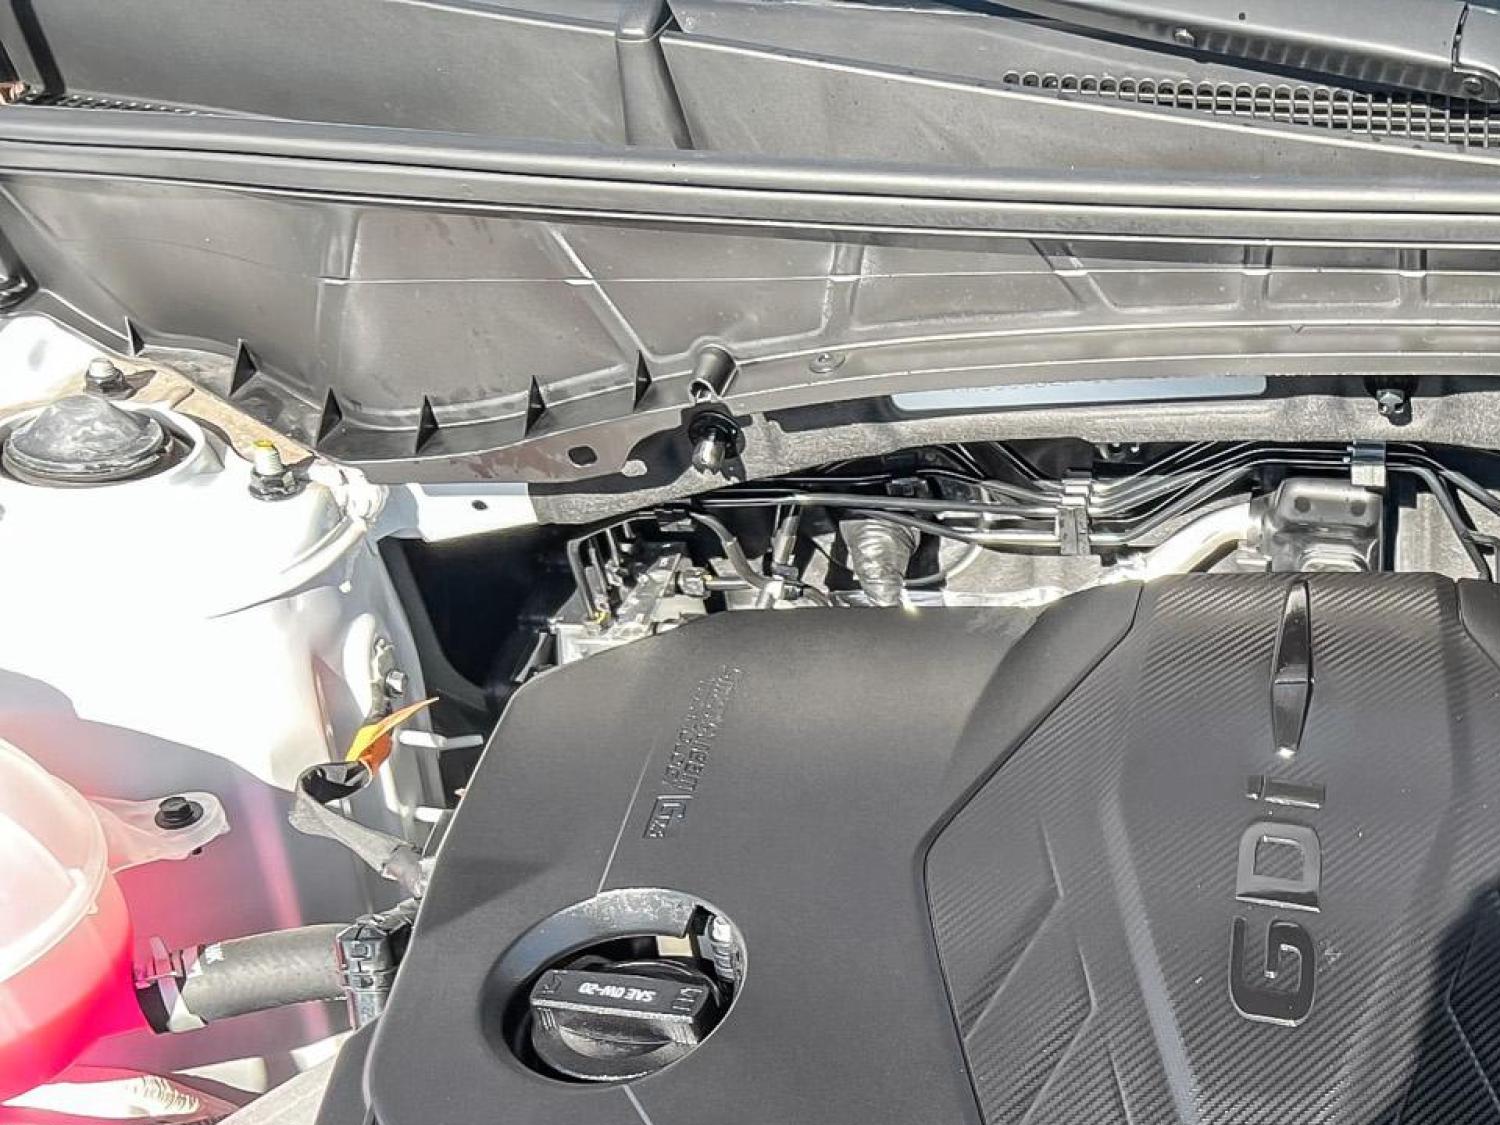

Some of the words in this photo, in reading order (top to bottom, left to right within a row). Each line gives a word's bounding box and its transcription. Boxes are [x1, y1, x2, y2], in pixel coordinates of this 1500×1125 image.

[1228, 775, 1326, 1027] GDi
[579, 983, 625, 998] 0W-20
[625, 988, 656, 1002] SAE
